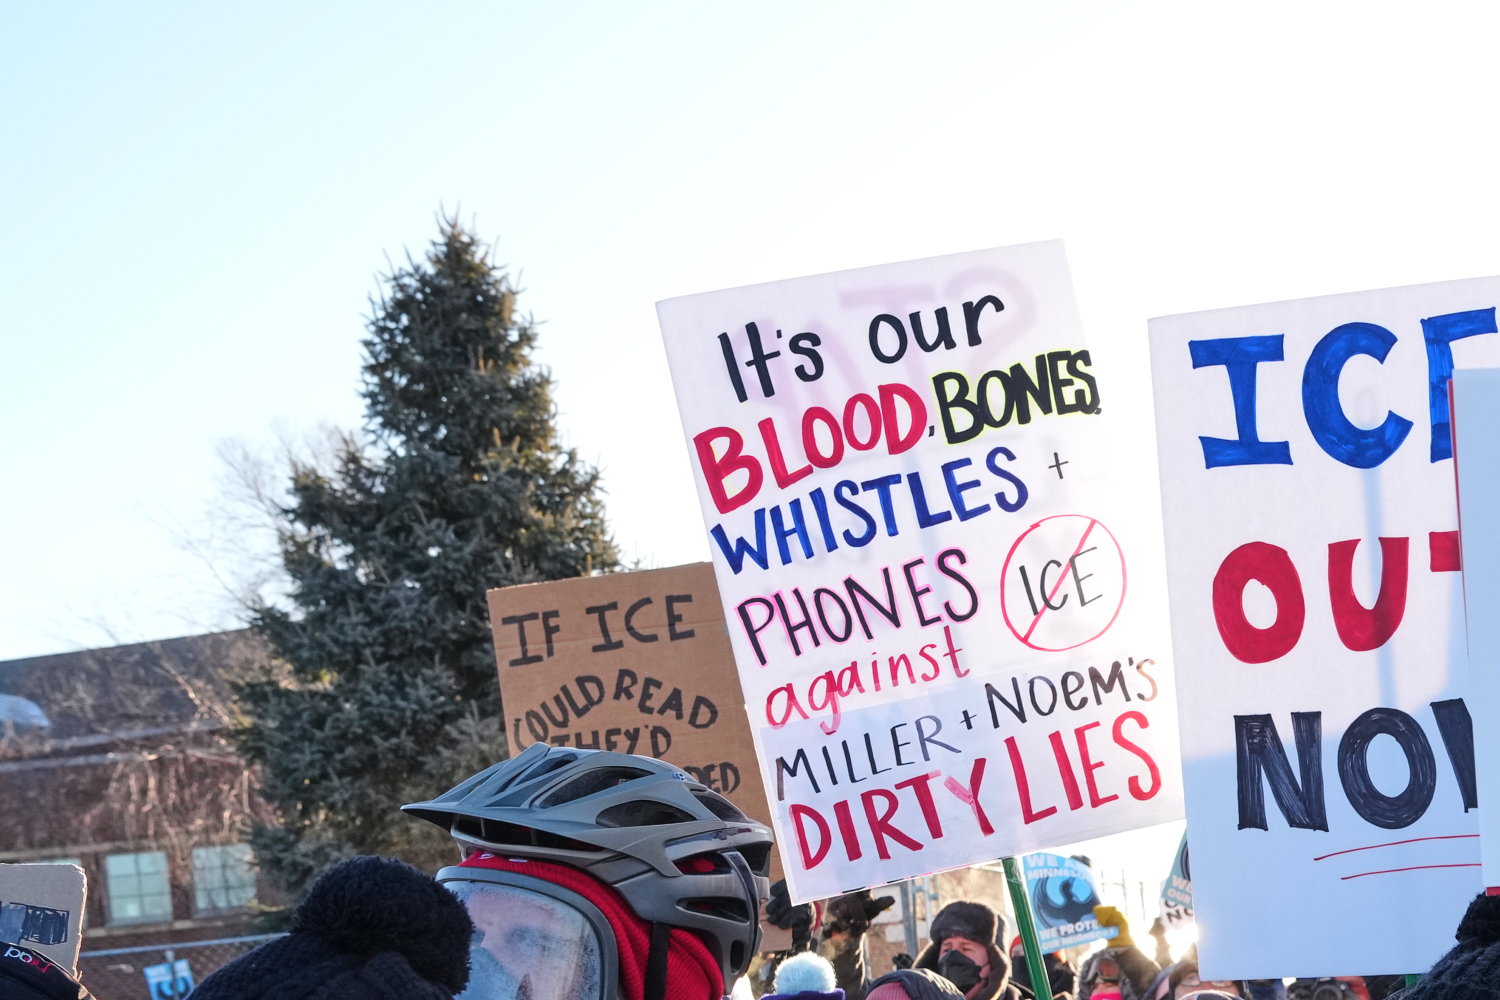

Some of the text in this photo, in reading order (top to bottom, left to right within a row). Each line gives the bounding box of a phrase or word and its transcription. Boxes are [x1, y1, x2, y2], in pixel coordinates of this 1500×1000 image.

[718, 296, 1004, 402] It's our
[711, 446, 1069, 575] WHISTLES +
[502, 594, 696, 667] IF ICE
[736, 546, 1103, 667] PHONES ICE
[1212, 531, 1462, 664] OU
[514, 668, 719, 752] COULD READ
[765, 625, 970, 734] against
[777, 715, 962, 800] MILLER
[960, 709, 977, 730] +
[787, 710, 1162, 870] DIRTY LIES
[1025, 854, 1058, 868] WE
